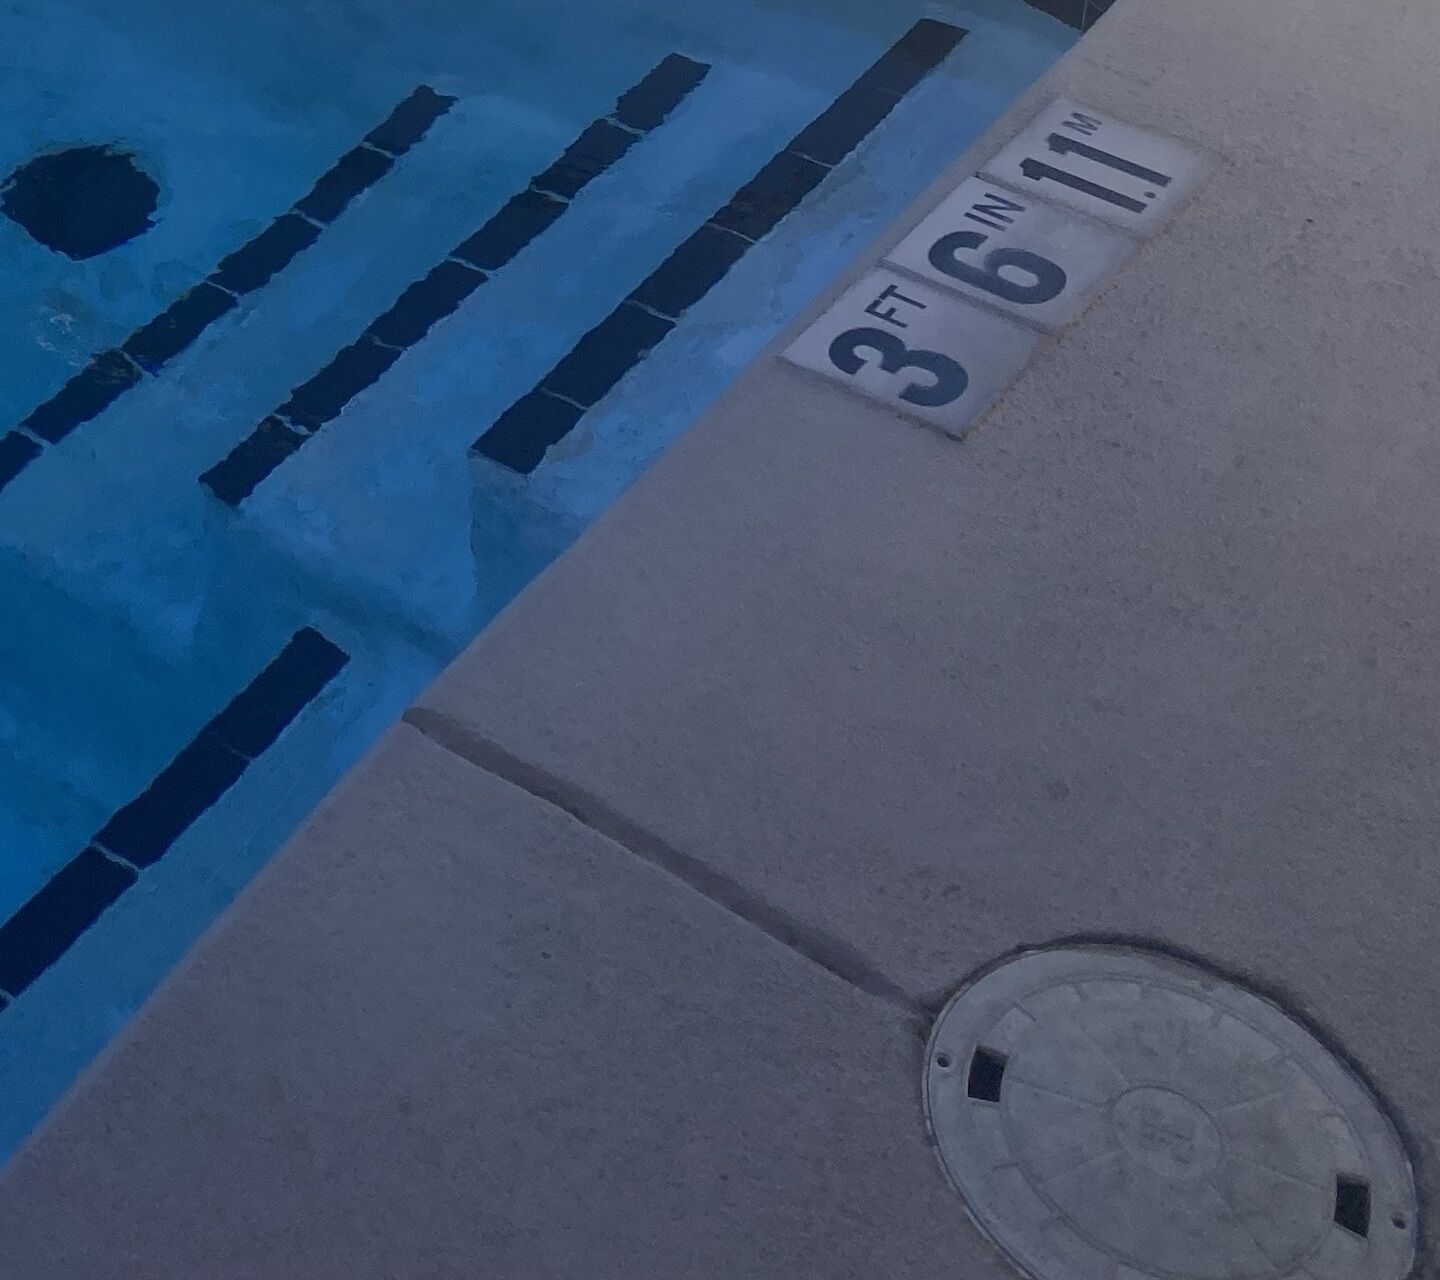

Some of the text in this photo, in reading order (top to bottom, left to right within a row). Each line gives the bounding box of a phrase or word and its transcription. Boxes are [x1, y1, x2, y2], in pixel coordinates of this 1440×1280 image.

[828, 111, 1173, 408] 3 FT 6 IN 1.1 M
